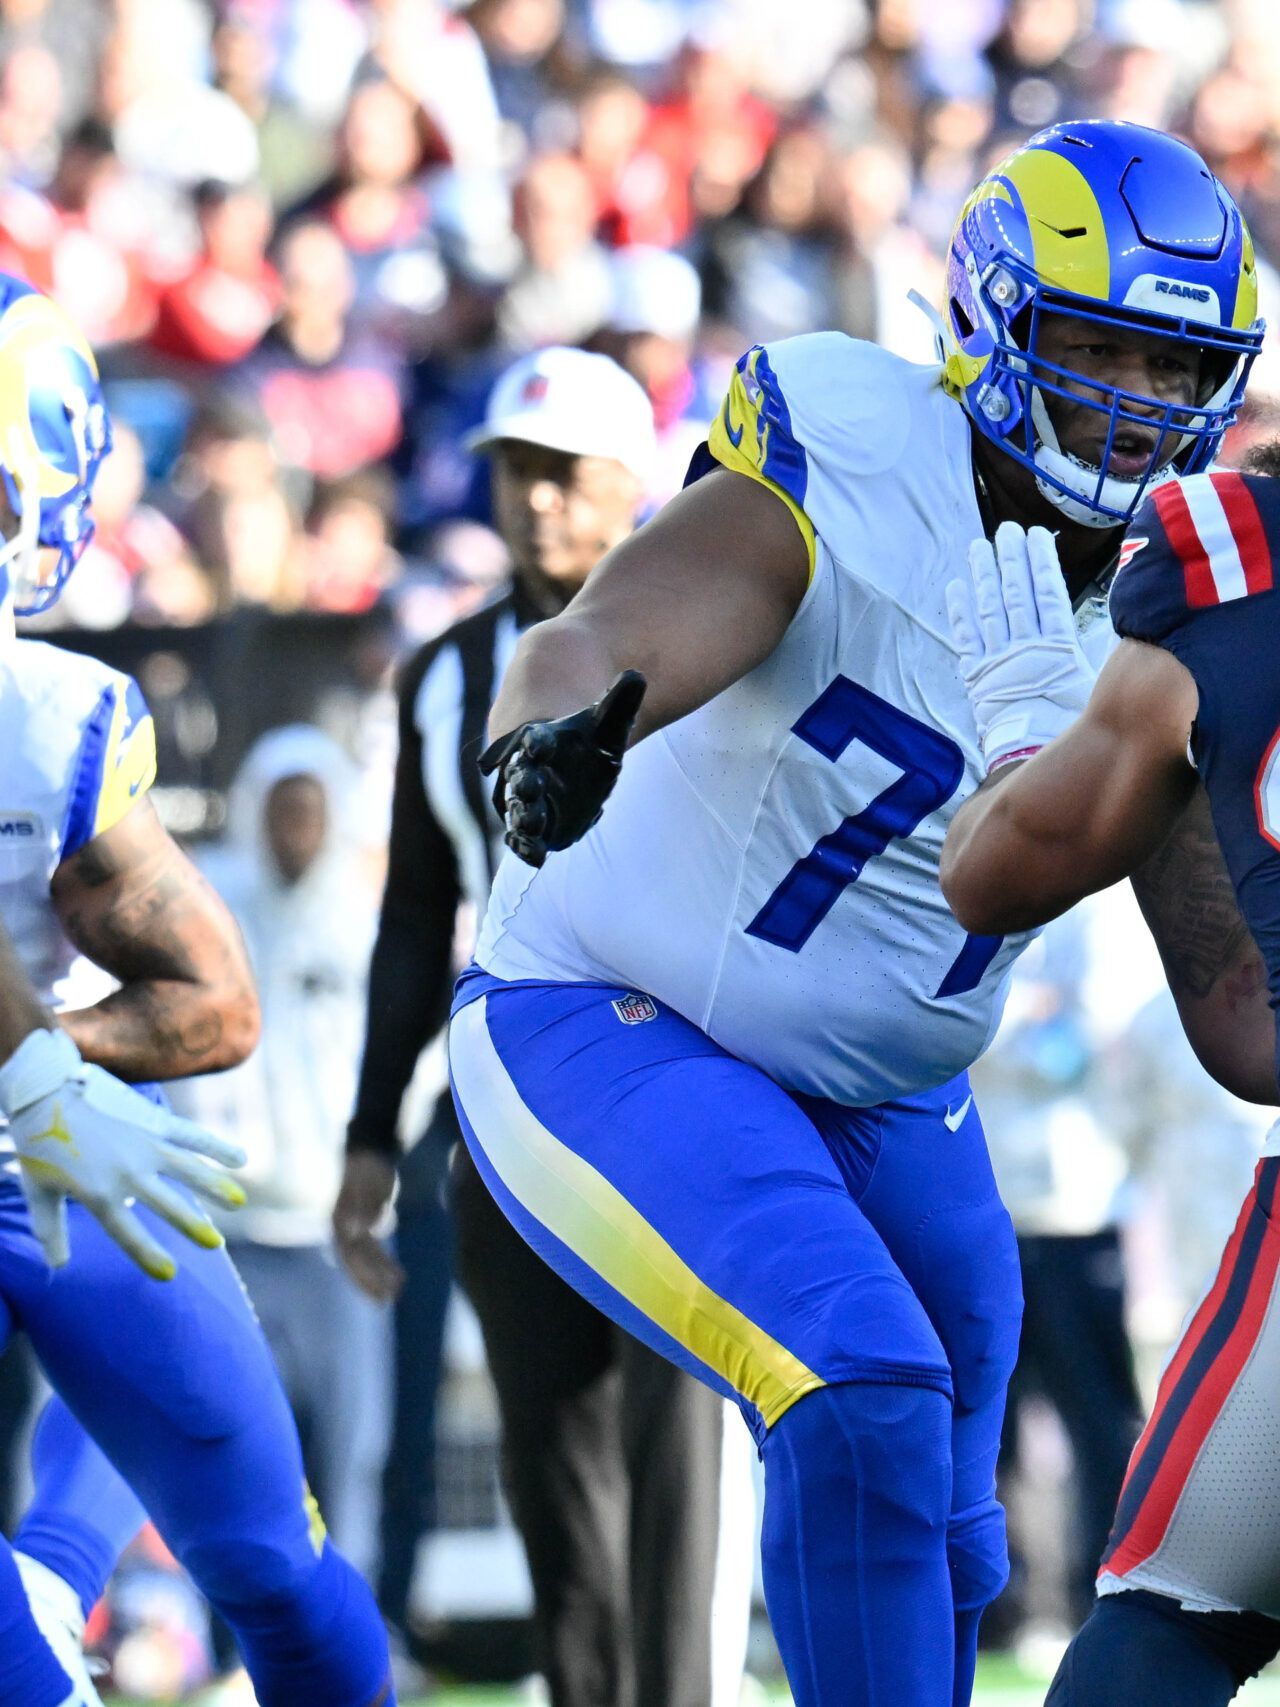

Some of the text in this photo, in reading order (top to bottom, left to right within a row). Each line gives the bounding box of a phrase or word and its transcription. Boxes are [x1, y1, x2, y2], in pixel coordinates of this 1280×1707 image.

[1155, 280, 1210, 303] RAMS
[744, 673, 1005, 999] 7
[624, 1003, 653, 1020] NFL
